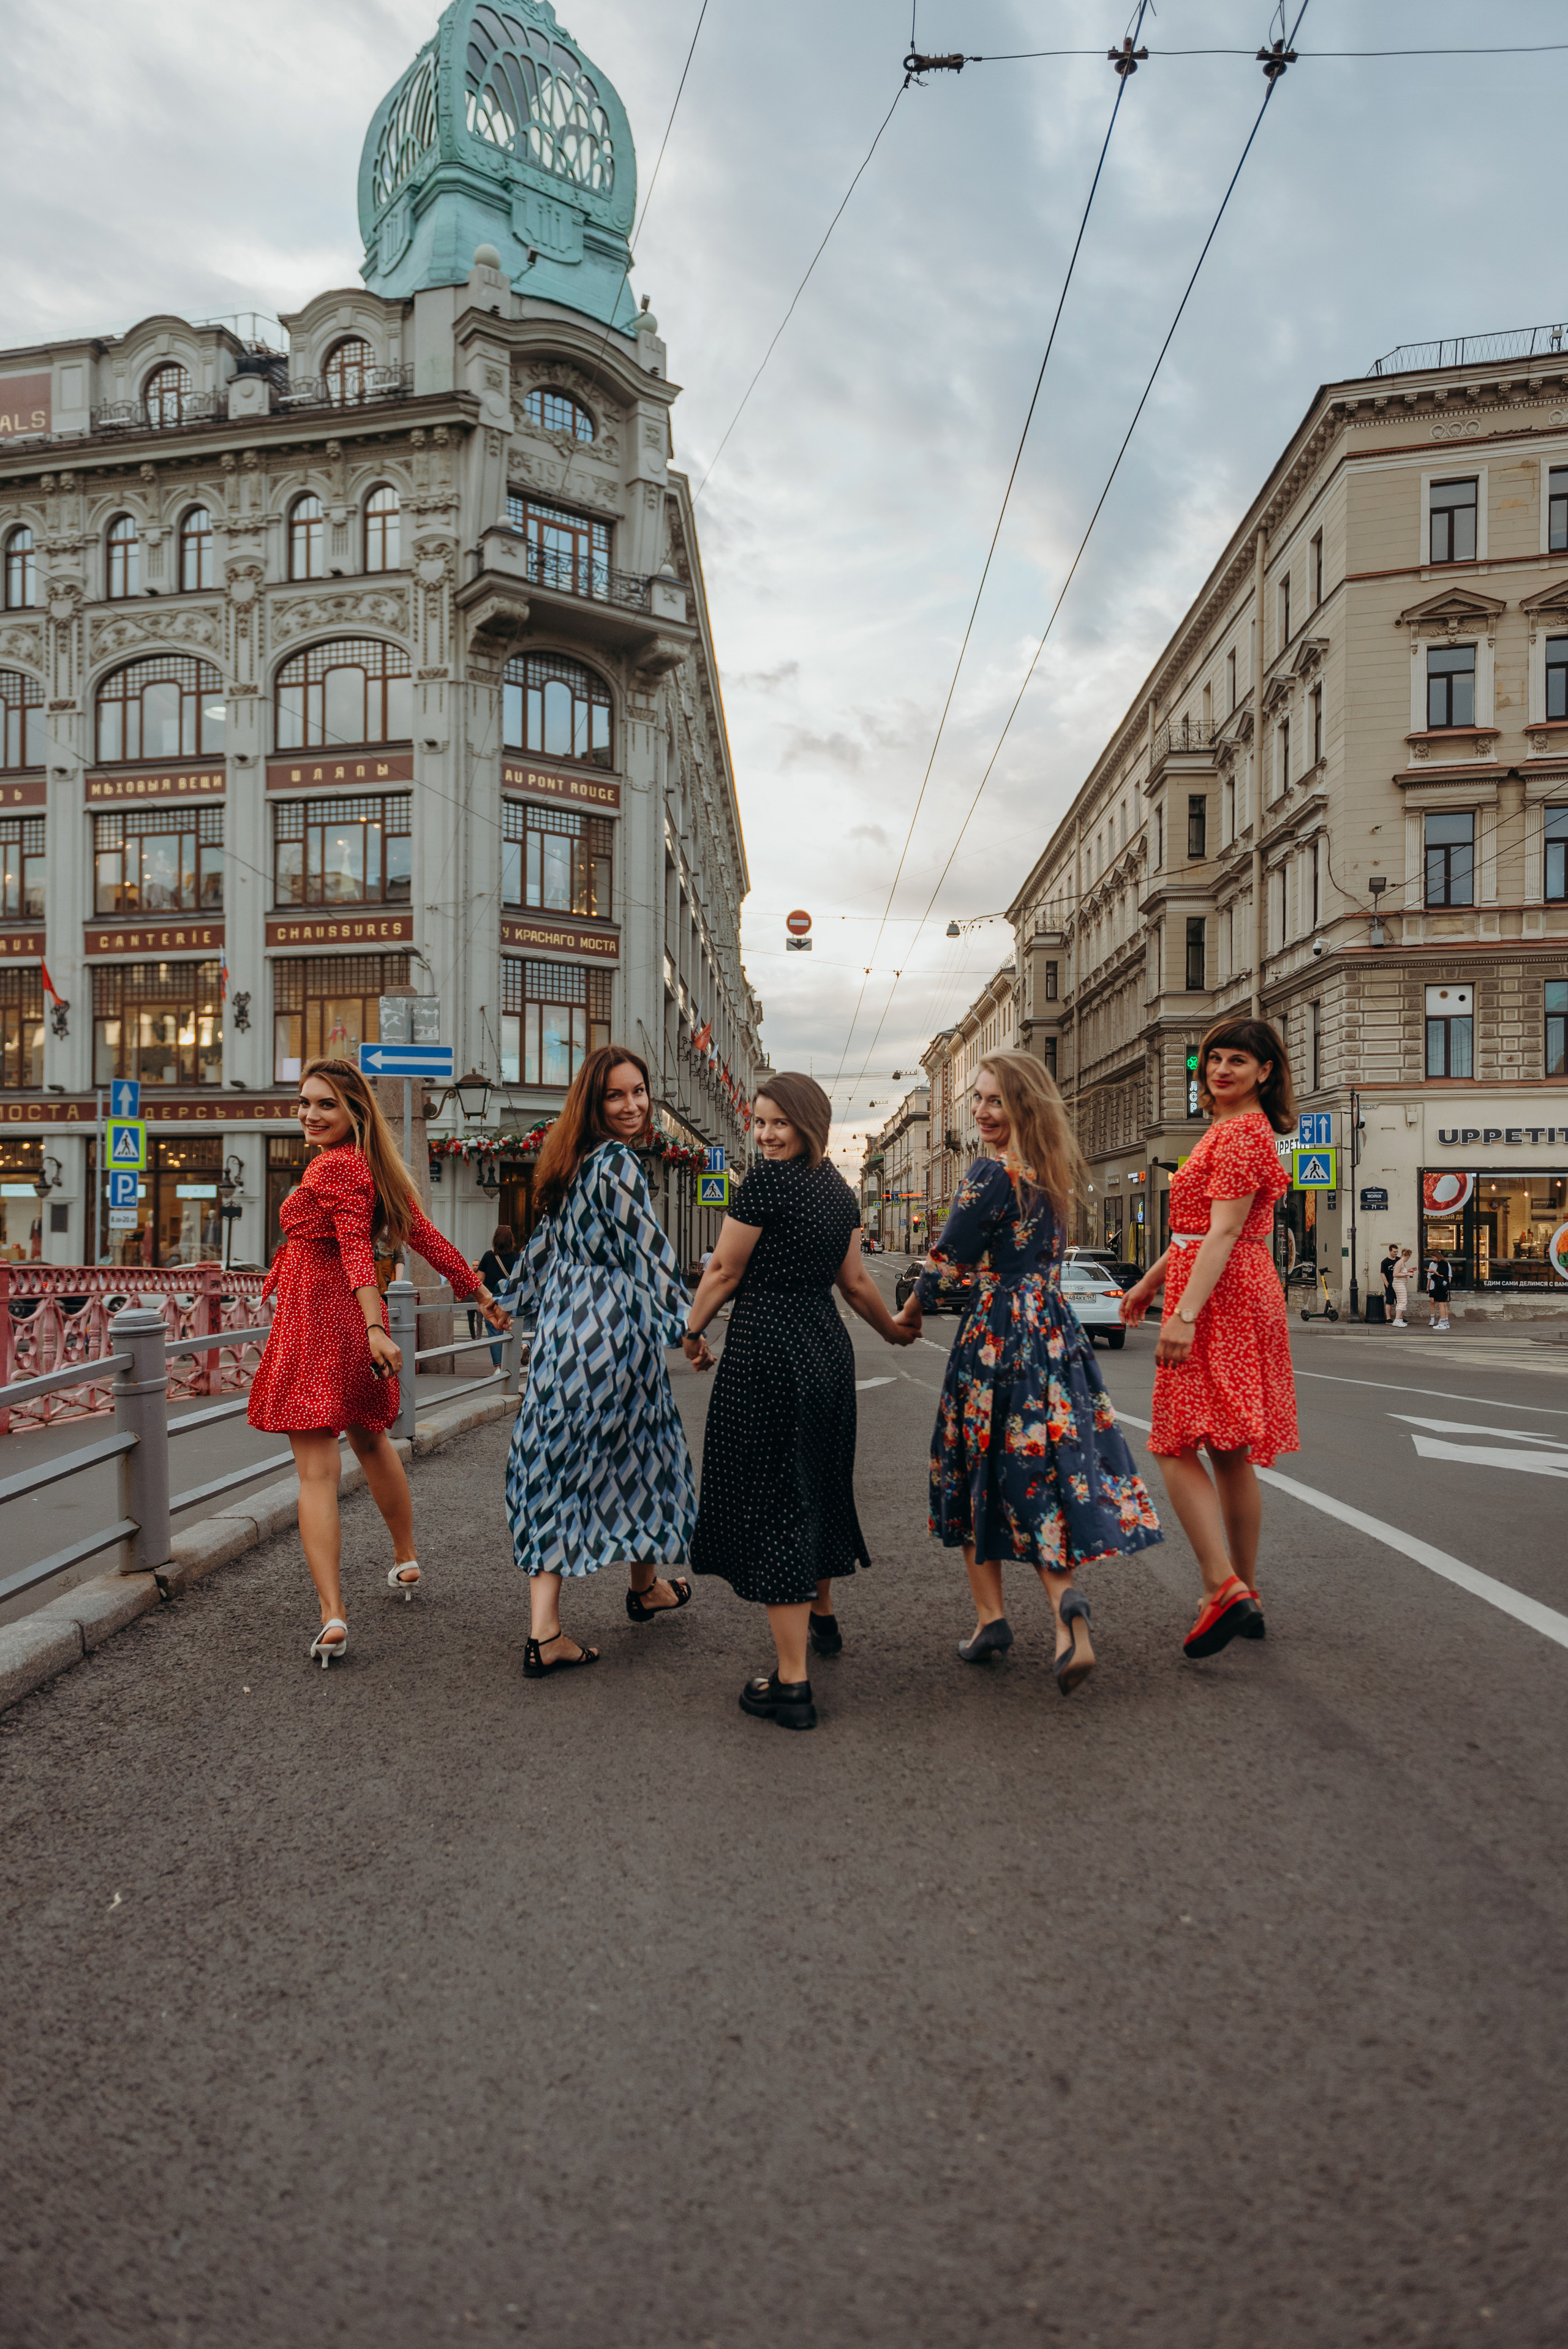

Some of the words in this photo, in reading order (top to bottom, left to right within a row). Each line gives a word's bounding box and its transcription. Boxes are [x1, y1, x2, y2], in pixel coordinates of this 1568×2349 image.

[0, 410, 46, 432] ALS
[178, 775, 222, 790] ВЕЩИ
[505, 769, 523, 784] AU
[527, 774, 564, 791] PONT
[570, 782, 615, 801] ROUGE
[277, 922, 402, 941] CHAUSSURES
[502, 926, 510, 938] У
[514, 928, 575, 946] КРАСНАГО
[580, 937, 616, 952] МОСТА
[1189, 1080, 1198, 1113] ЛОР
[0, 1104, 80, 1121] ОСТА
[254, 1106, 299, 1118] СХЕ
[1438, 1128, 1568, 1145] UPPETIT
